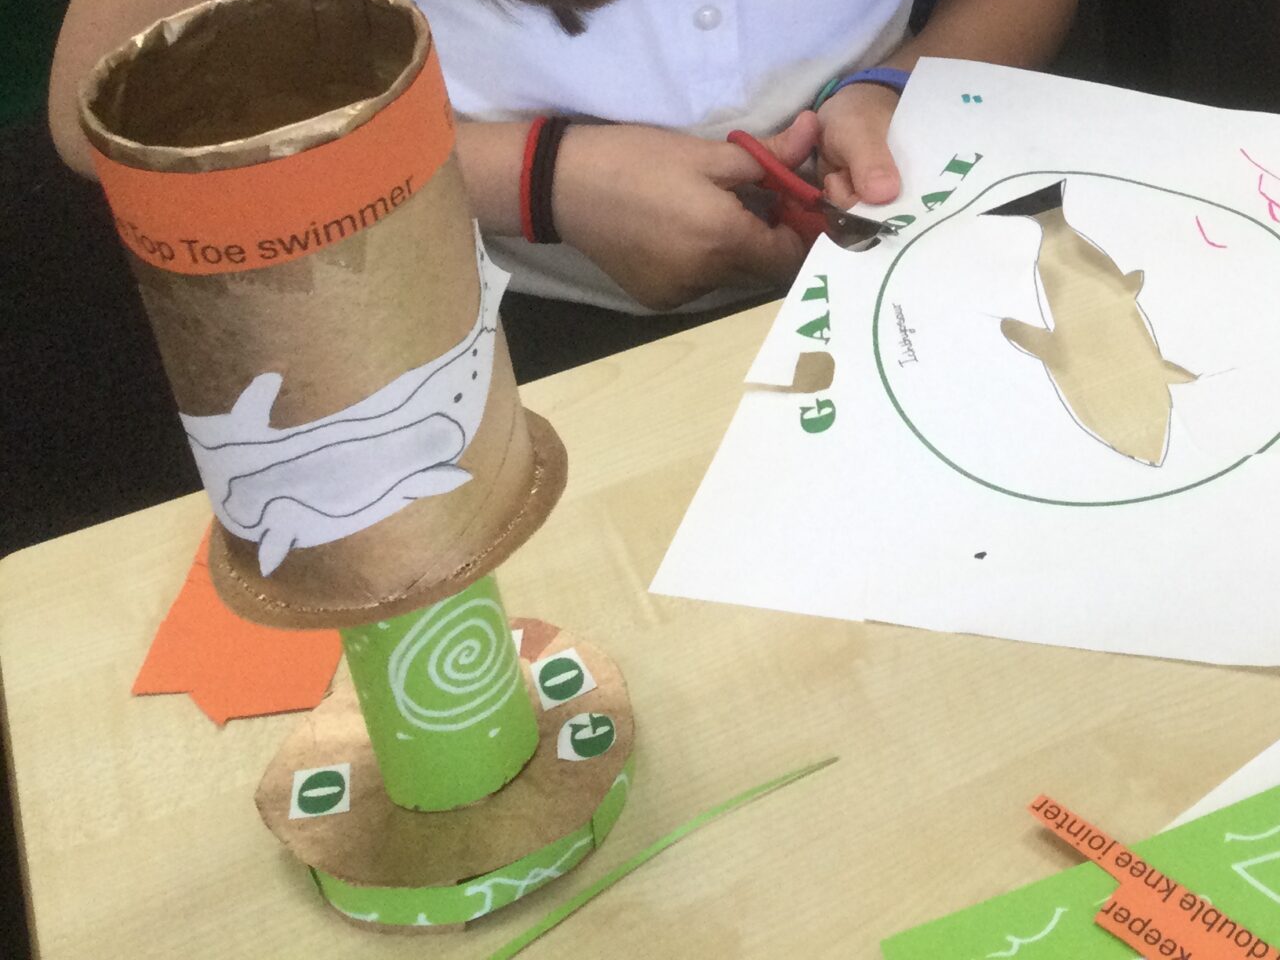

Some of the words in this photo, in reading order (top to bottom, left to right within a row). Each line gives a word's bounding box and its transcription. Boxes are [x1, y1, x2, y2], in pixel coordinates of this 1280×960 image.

[180, 238, 246, 265] Toe
[258, 174, 414, 260] swimmer
[538, 656, 585, 701] O
[297, 769, 346, 814] O
[1031, 799, 1118, 861] jointer
[1114, 849, 1178, 903] knee
[1178, 890, 1270, 959] double
